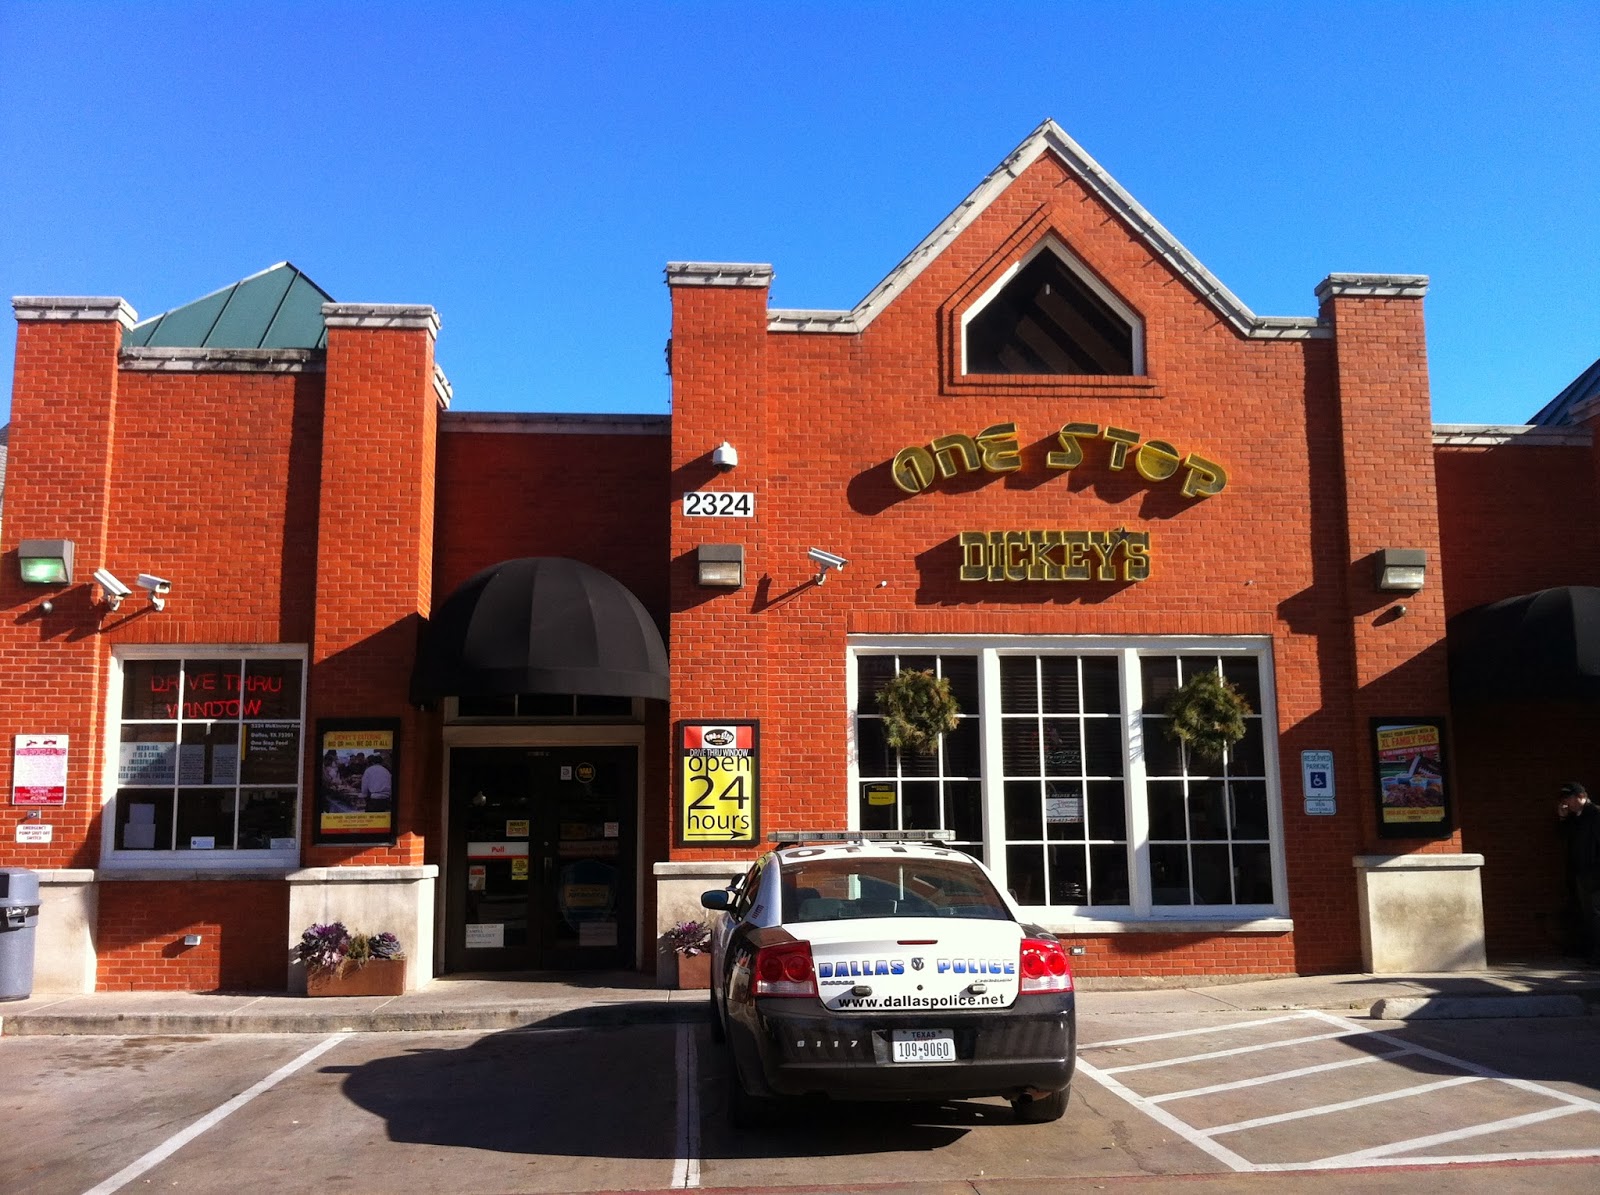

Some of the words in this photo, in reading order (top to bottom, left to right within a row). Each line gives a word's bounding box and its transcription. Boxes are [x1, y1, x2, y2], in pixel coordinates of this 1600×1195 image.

[892, 422, 1022, 494] ONE
[1046, 422, 1228, 498] STOP
[686, 493, 751, 515] 2324
[959, 526, 1150, 582] DICKEY'S
[151, 673, 217, 692] DRVE
[224, 674, 283, 692] THRU
[166, 699, 262, 719] WINDOW
[706, 748, 722, 757] THRU
[722, 748, 749, 757] WINDOW
[688, 757, 750, 777] open
[689, 775, 750, 810] 24
[688, 809, 750, 830] hours
[818, 959, 905, 978] DALLAS
[936, 958, 1016, 975] POLICE
[838, 993, 1005, 1010] www.dallaspolice.net
